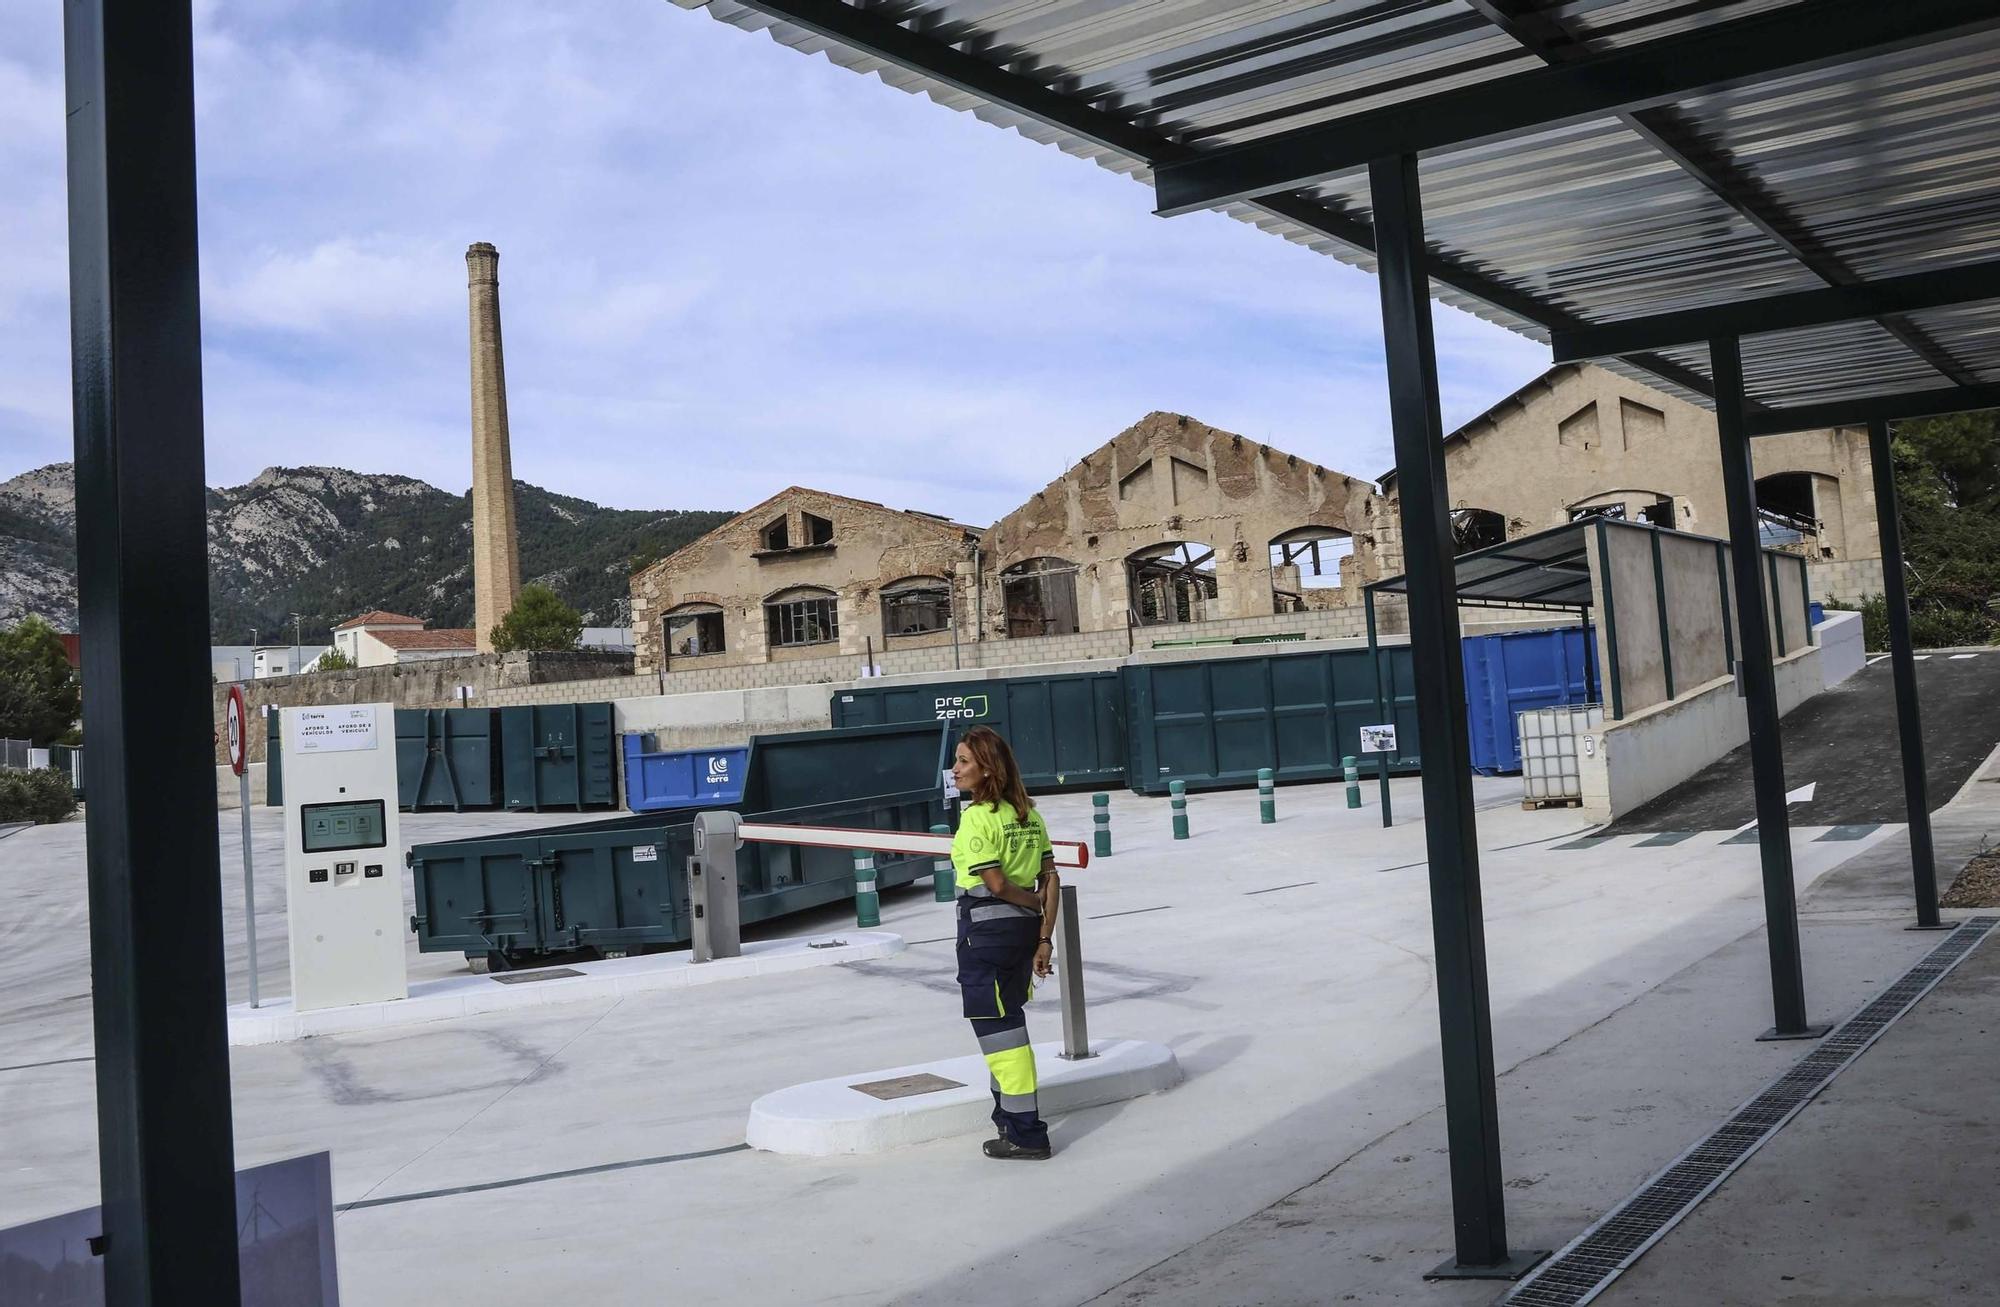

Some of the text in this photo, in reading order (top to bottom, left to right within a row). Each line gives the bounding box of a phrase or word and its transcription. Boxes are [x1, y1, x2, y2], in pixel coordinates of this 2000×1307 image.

[935, 696, 963, 710] pre
[935, 708, 974, 720] zero
[230, 715, 238, 746] 20
[706, 776, 729, 784] terra
